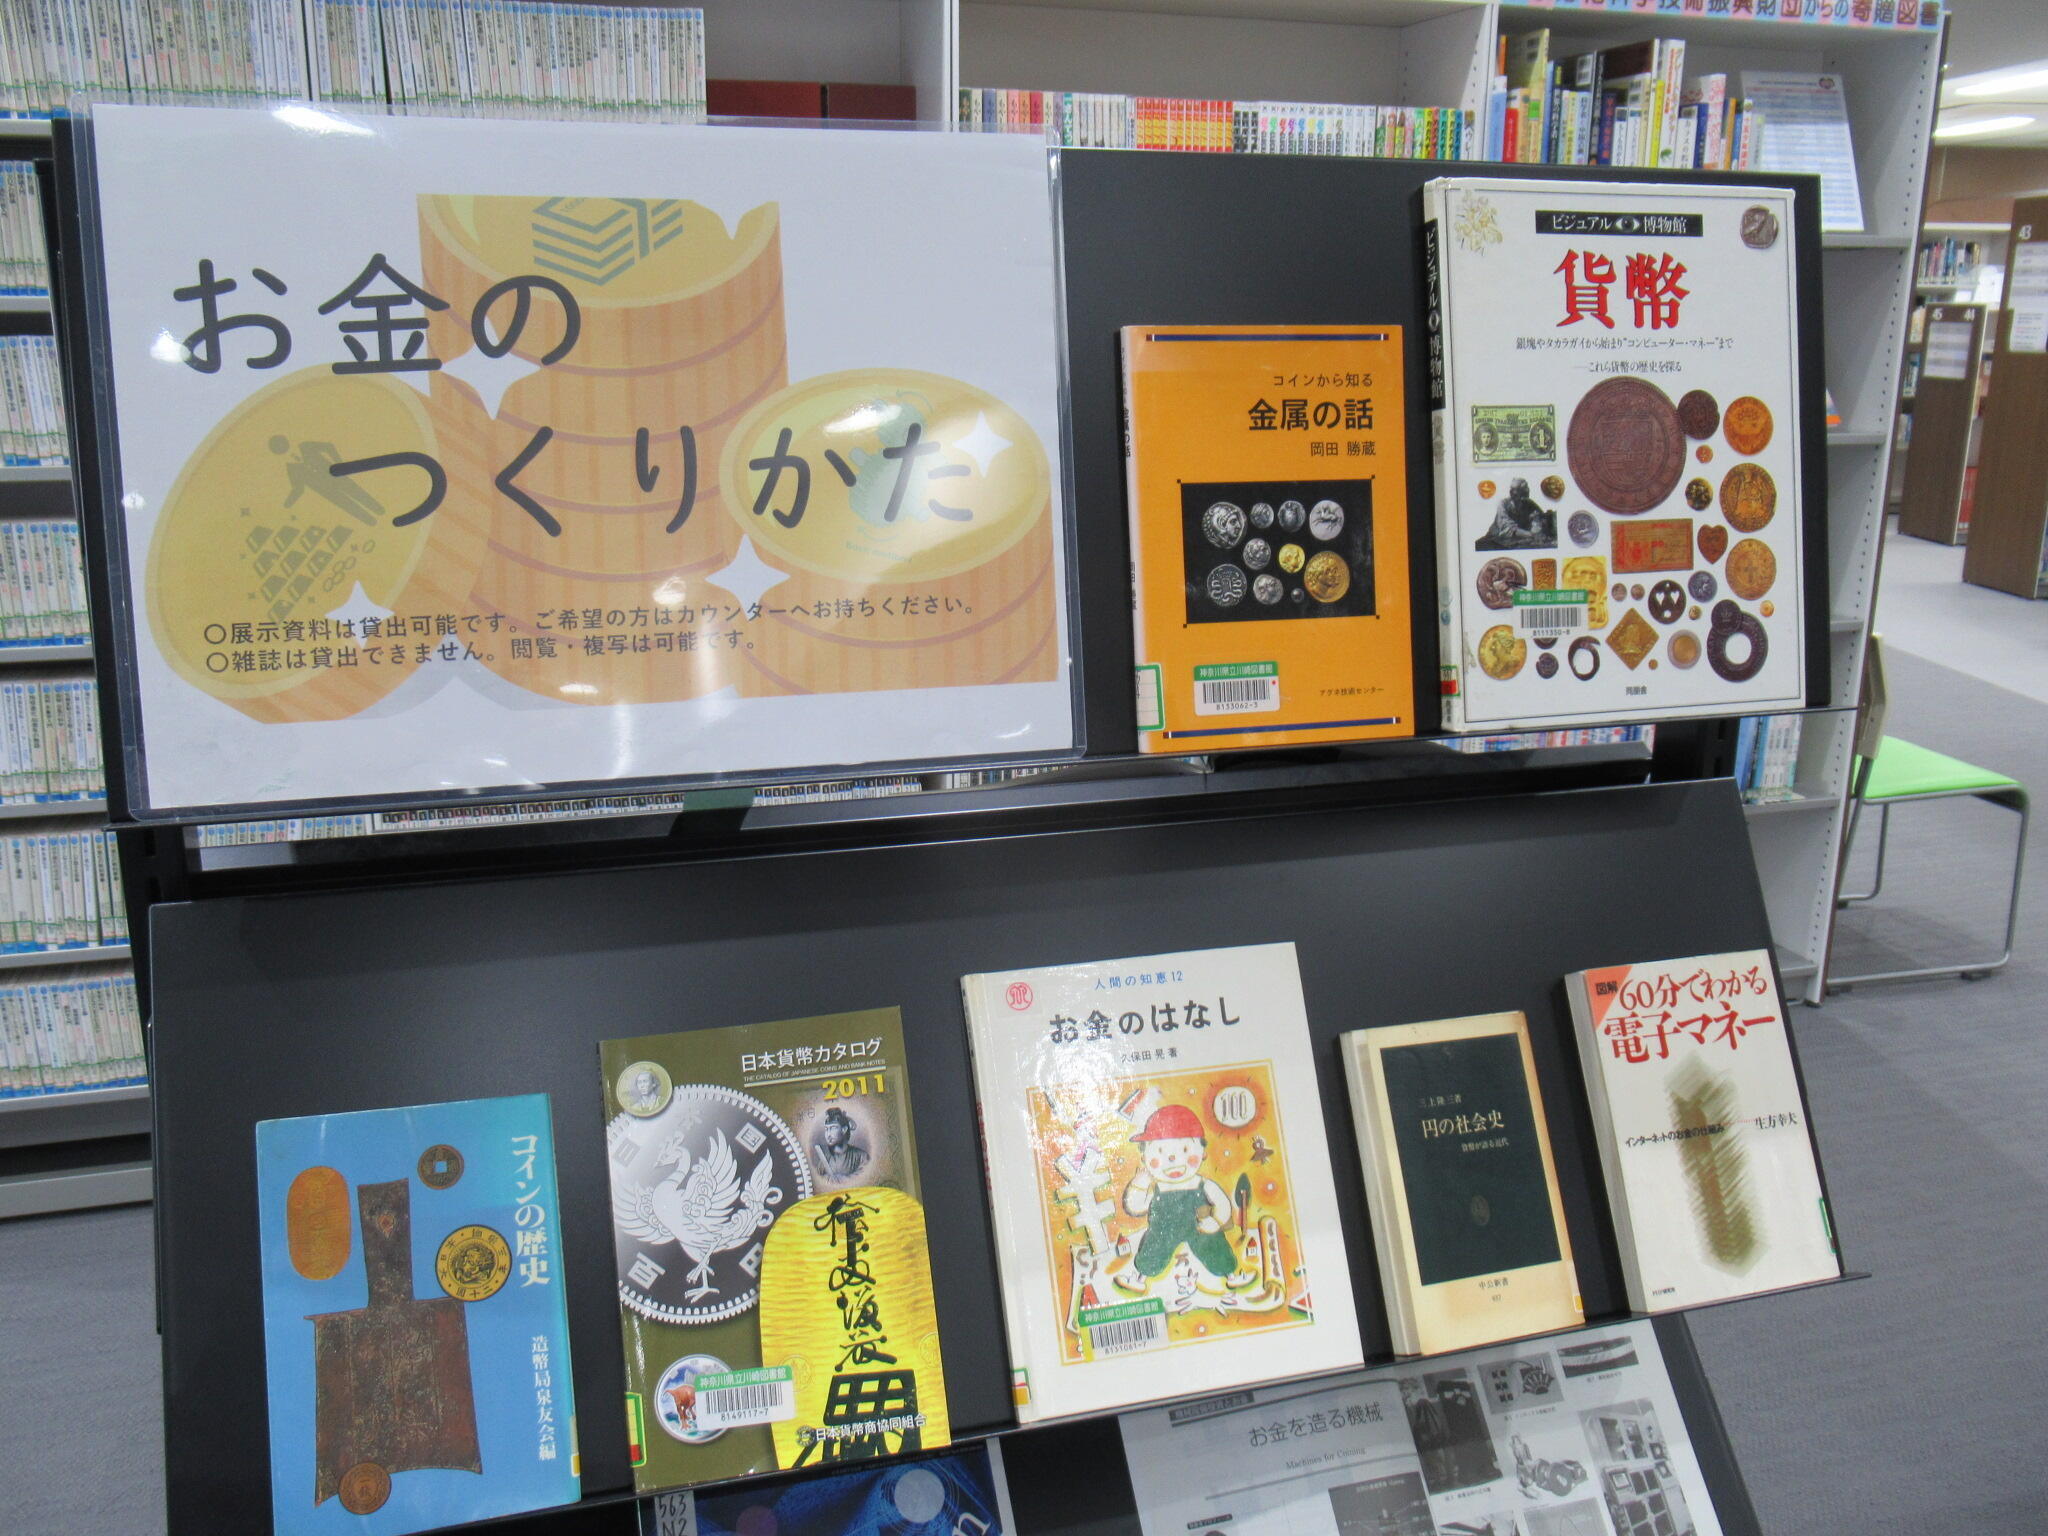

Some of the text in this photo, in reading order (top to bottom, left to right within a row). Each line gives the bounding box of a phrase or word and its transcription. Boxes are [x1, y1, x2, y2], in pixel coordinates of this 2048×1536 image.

[1551, 213, 1688, 234] ビジュアル 博物館
[1553, 249, 1691, 330] 貨幣
[172, 252, 582, 375] お金の
[1273, 371, 1373, 388] コインから知る
[1248, 398, 1374, 431] 金属の話
[1310, 440, 1376, 457] 岡田 勝蔵
[329, 422, 974, 537] つくりかた
[1216, 702, 1258, 711] 8133062-3
[1595, 981, 1618, 995] 図解
[1619, 966, 1768, 1011] 60分でわかる
[1049, 997, 1241, 1044] お金のはなし
[1603, 1001, 1776, 1064] 電子マネー
[741, 1036, 883, 1073] 日本貨幣カタログ
[1121, 1050, 1153, 1064] 久保田
[822, 1073, 886, 1100] 2011
[1220, 1089, 1249, 1121] 100
[1422, 1109, 1505, 1139] 円の社会史
[1625, 1123, 1726, 1148] インターネットのお金の仕組み
[511, 1134, 551, 1288] コインの歴史
[699, 1367, 787, 1388] 神奈川県立川崎図書館
[531, 1335, 556, 1462] 造幣局泉友会編
[720, 1407, 770, 1422] 8149117-7
[815, 1414, 928, 1442] 日本貨幣商協同組合
[1249, 1401, 1384, 1448] お金を造る機械
[1286, 1447, 1367, 1470] Machines for Coining
[656, 1493, 688, 1513] 563
